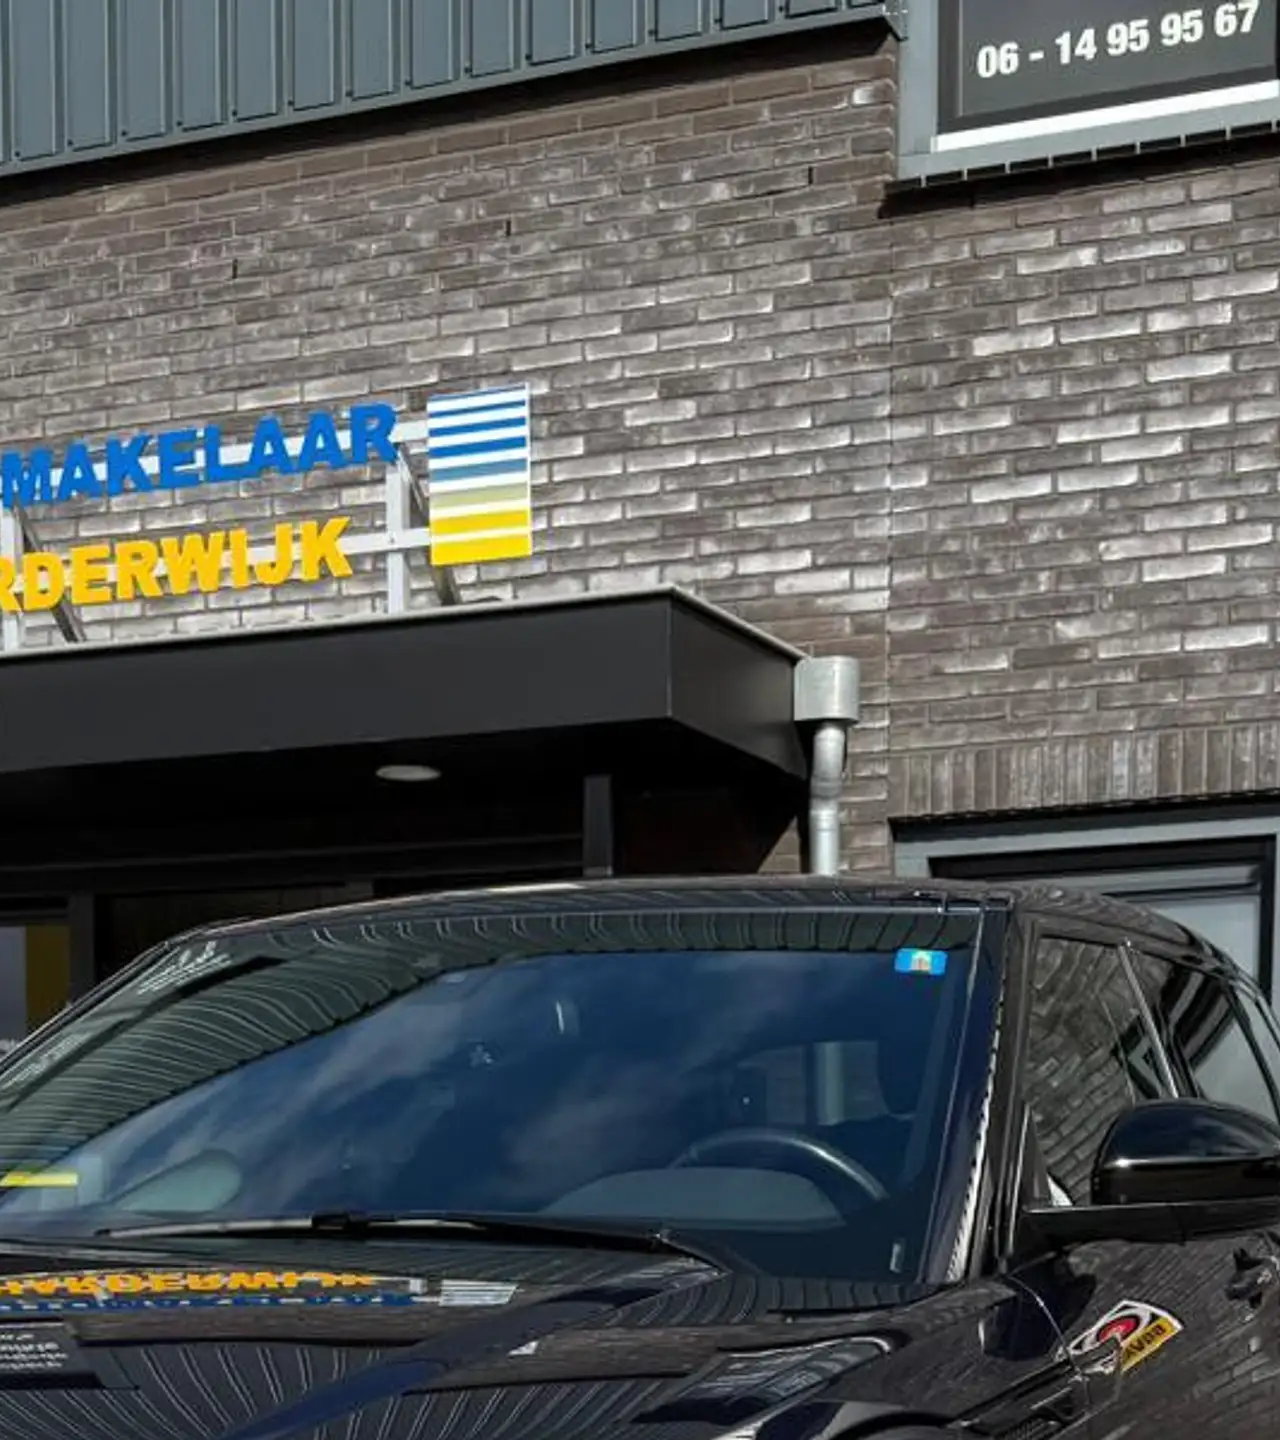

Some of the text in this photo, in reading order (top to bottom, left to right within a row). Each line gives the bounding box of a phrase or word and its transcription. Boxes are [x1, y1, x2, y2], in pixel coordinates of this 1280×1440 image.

[976, 42, 1019, 78] 06
[1054, 28, 1096, 65] 14
[1106, 19, 1150, 57] 95
[1161, 9, 1203, 47] 95
[1214, 0, 1260, 38] 67
